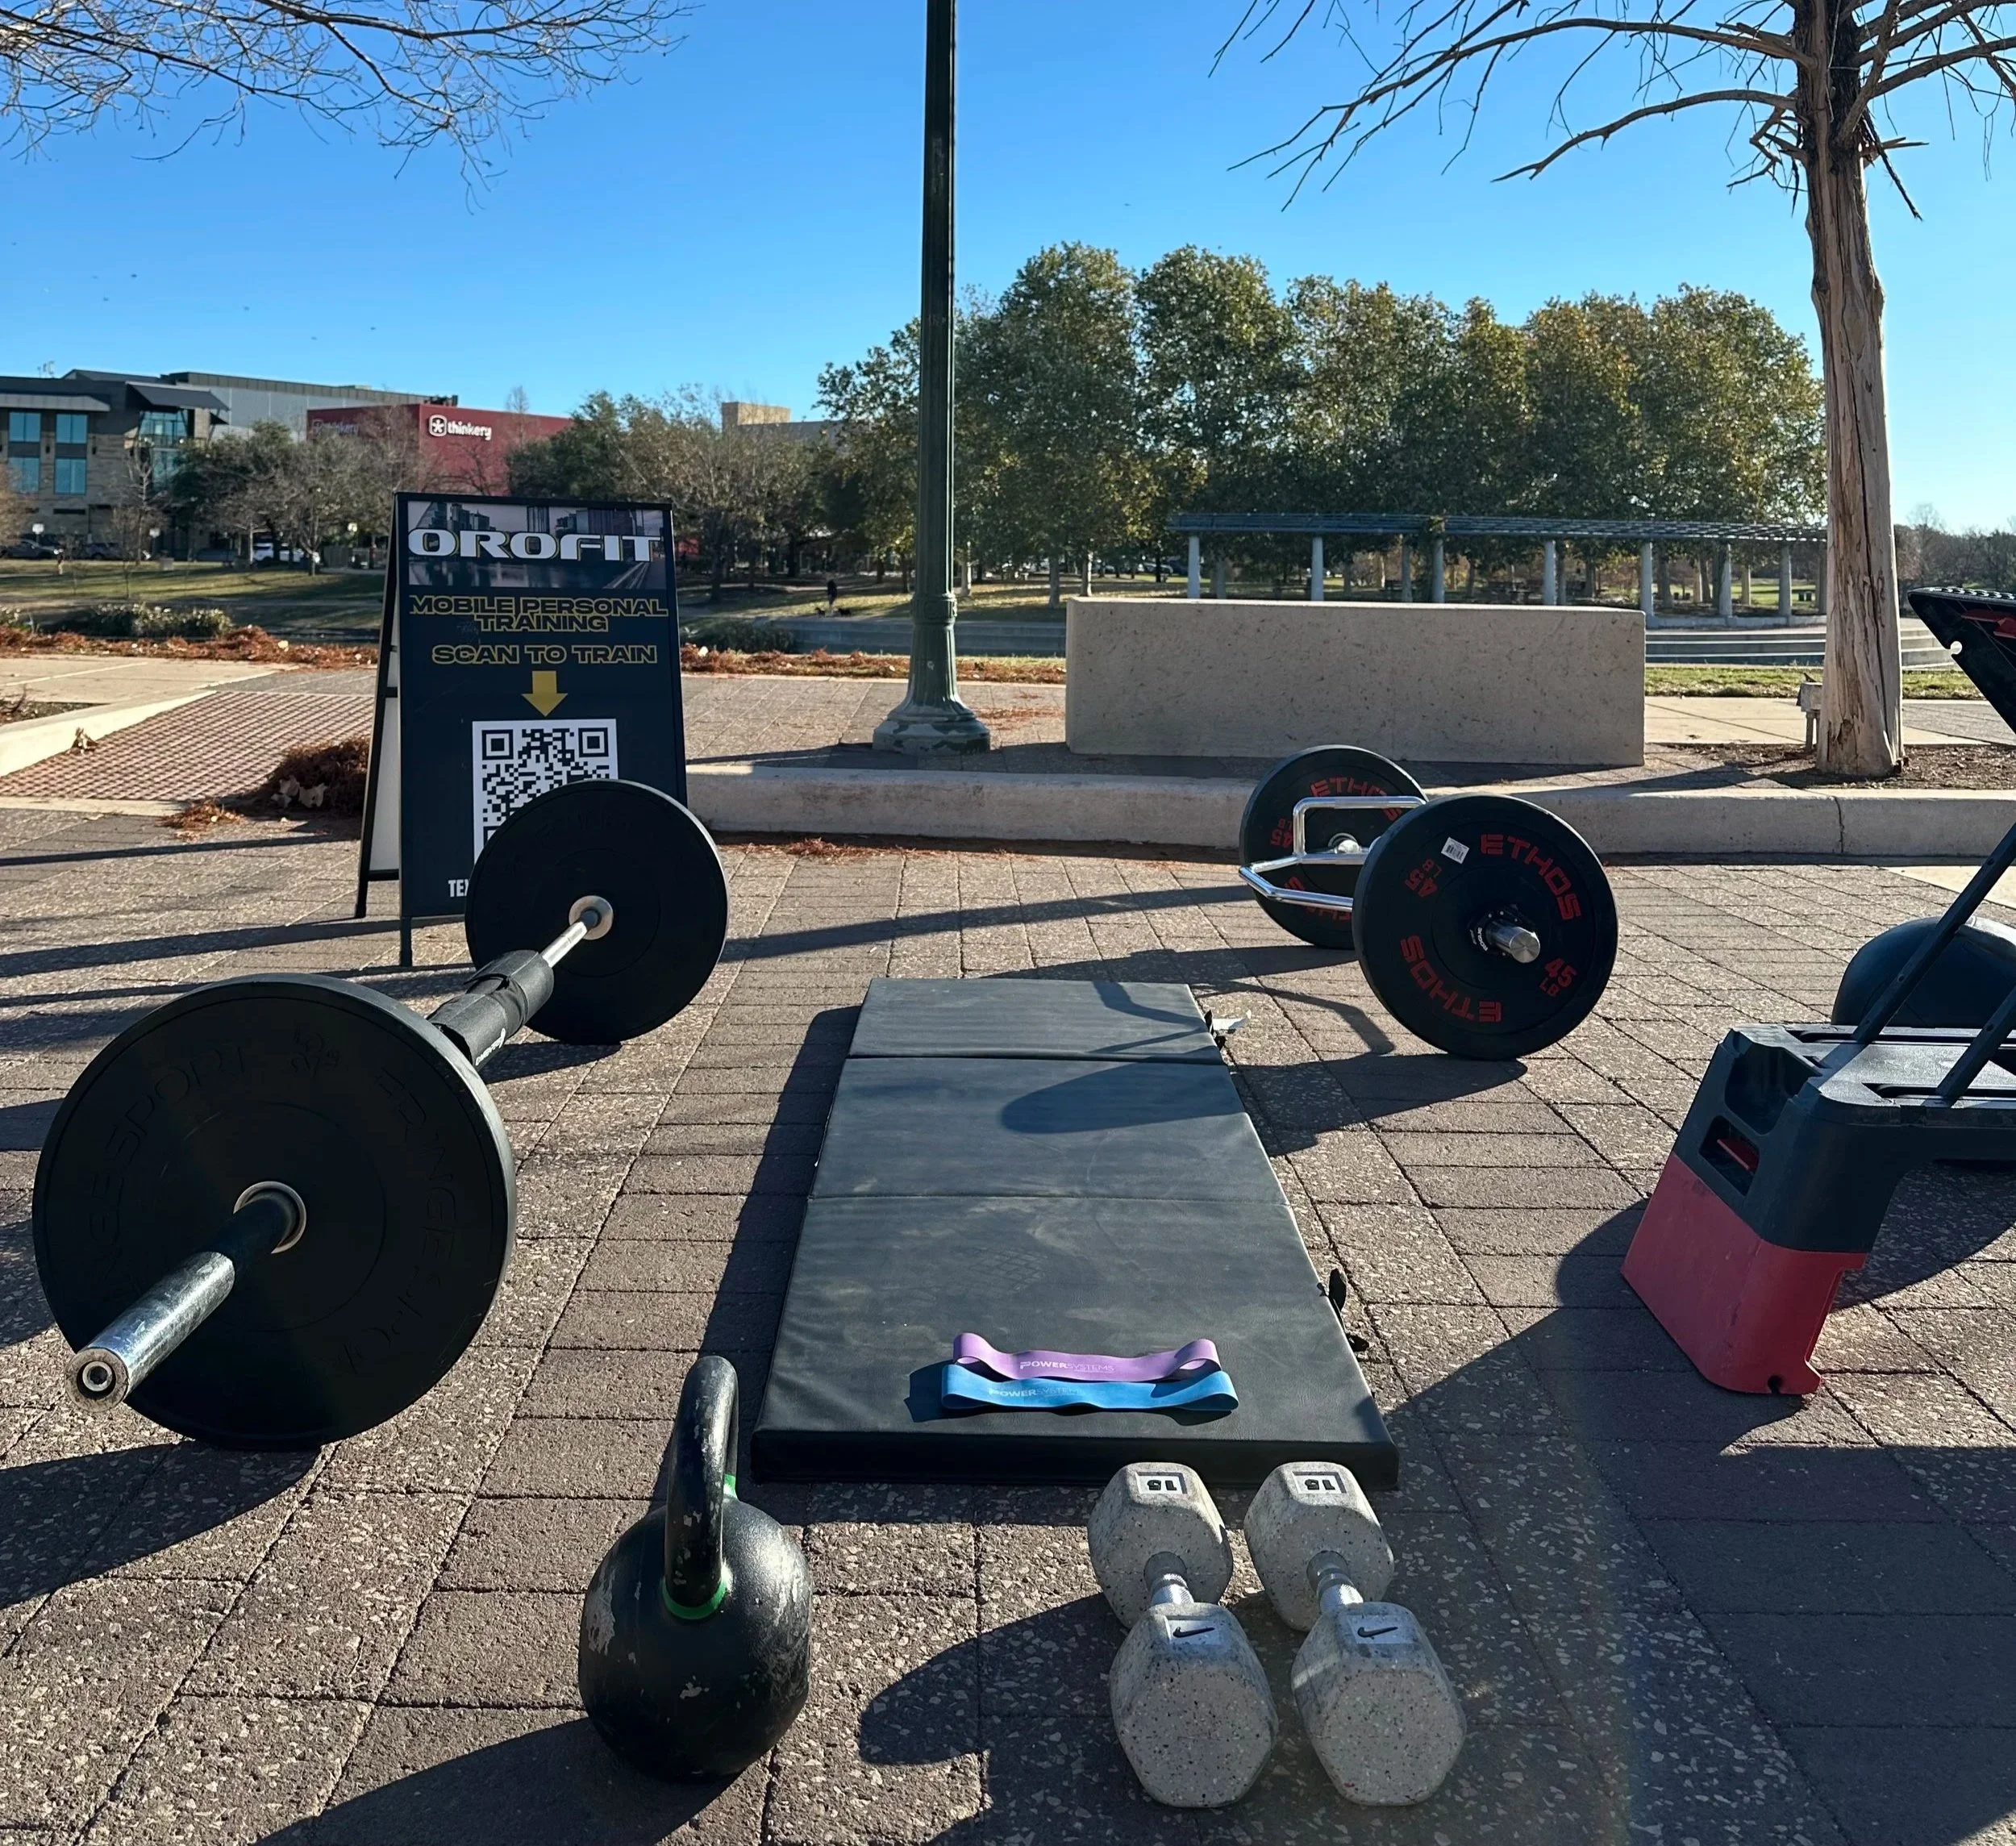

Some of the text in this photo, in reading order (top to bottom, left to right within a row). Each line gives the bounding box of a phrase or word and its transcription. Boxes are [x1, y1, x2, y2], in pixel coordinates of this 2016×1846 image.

[448, 421, 492, 440] thinkery
[408, 528, 661, 562] OROFIT
[410, 594, 669, 617] MOBILE PERSONAL
[474, 615, 609, 632] TRAINING
[431, 645, 658, 665] SCAN TO TRAIN
[1422, 859, 1443, 878] LB
[1480, 833, 1581, 921] ETHOS
[1405, 869, 1438, 898] 45
[1477, 927, 1489, 952] ROGUE
[1399, 935, 1502, 1023] ETHOS
[1543, 957, 1577, 988] 45
[1539, 977, 1560, 998] LB
[1146, 1479, 1177, 1491] 15
[1304, 1478, 1335, 1491] 15
